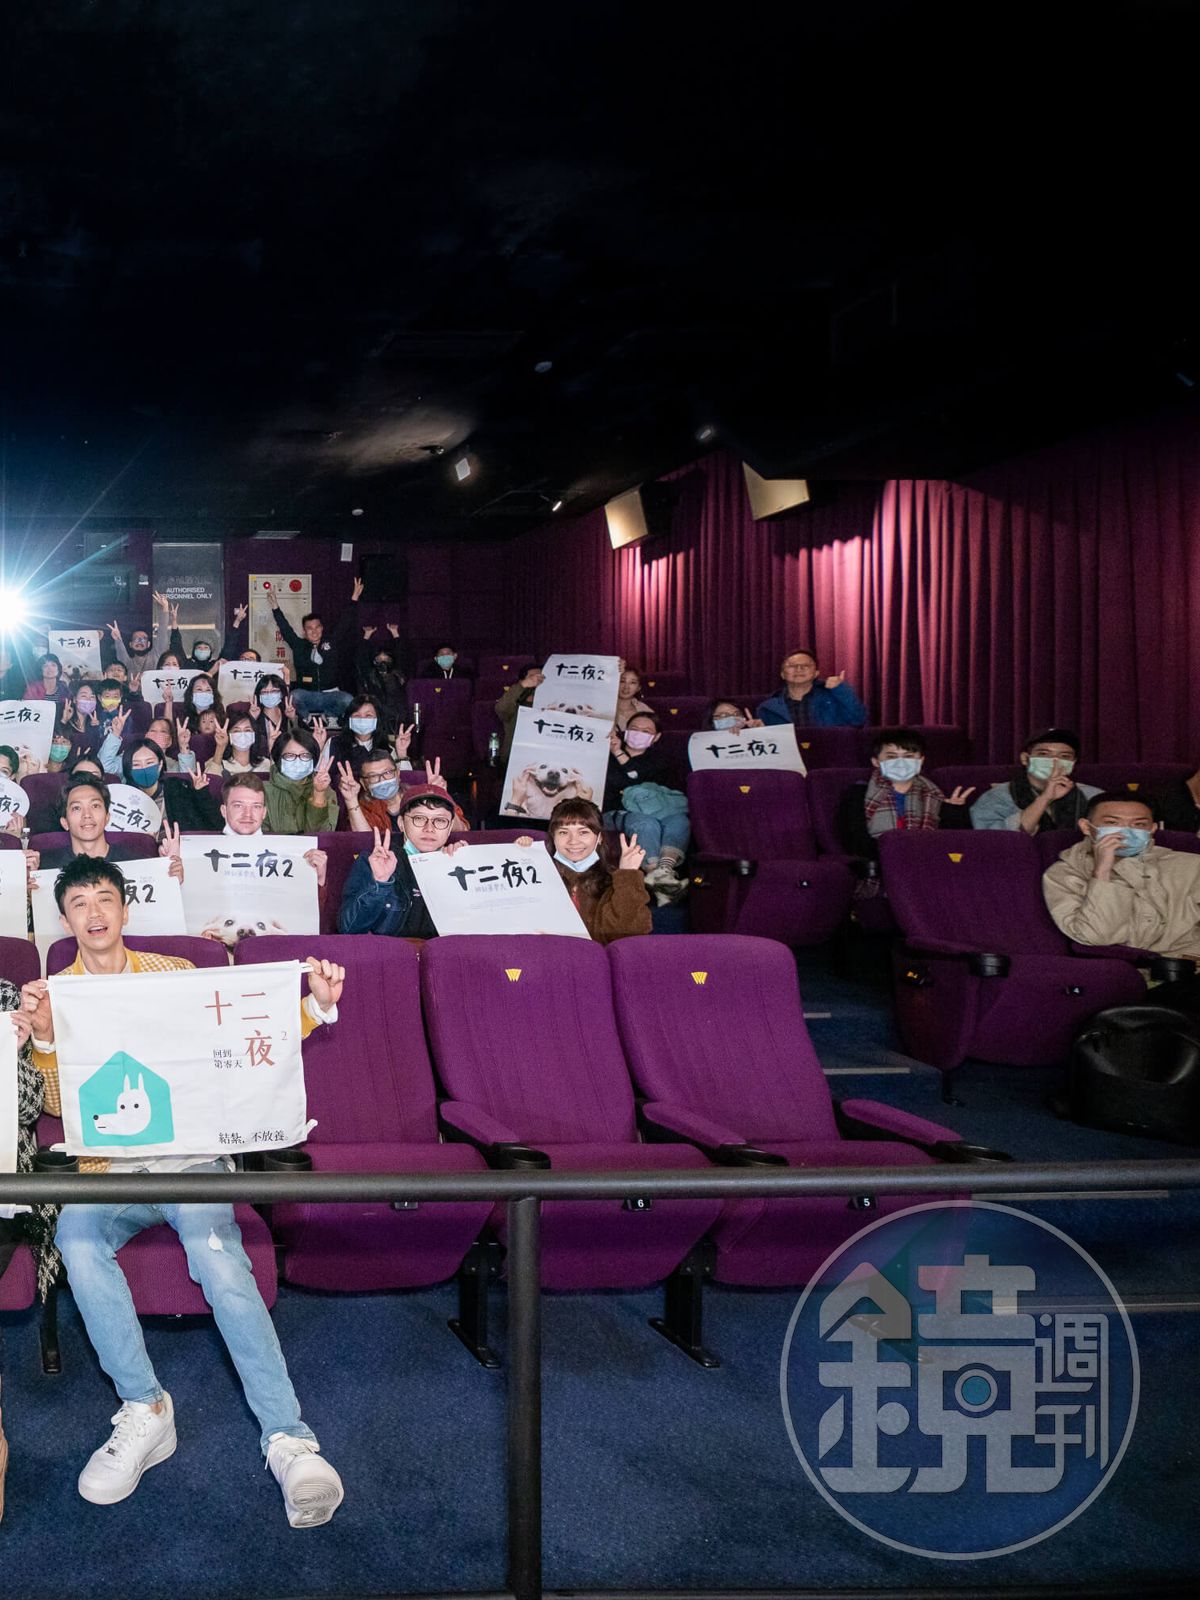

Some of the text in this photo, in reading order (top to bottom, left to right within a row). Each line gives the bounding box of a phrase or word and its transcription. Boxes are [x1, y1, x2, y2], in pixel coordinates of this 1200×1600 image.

[58, 635, 91, 648] 十二夜2
[555, 663, 605, 681] 十二夜2
[533, 718, 595, 743] 十二夜2
[705, 739, 780, 759] 十二夜2
[110, 801, 151, 832] 二夜2
[204, 849, 294, 878] 十二夜2
[448, 858, 542, 891] 十二夜2
[637, 1199, 644, 1208] 6
[863, 1198, 870, 1207] 5
